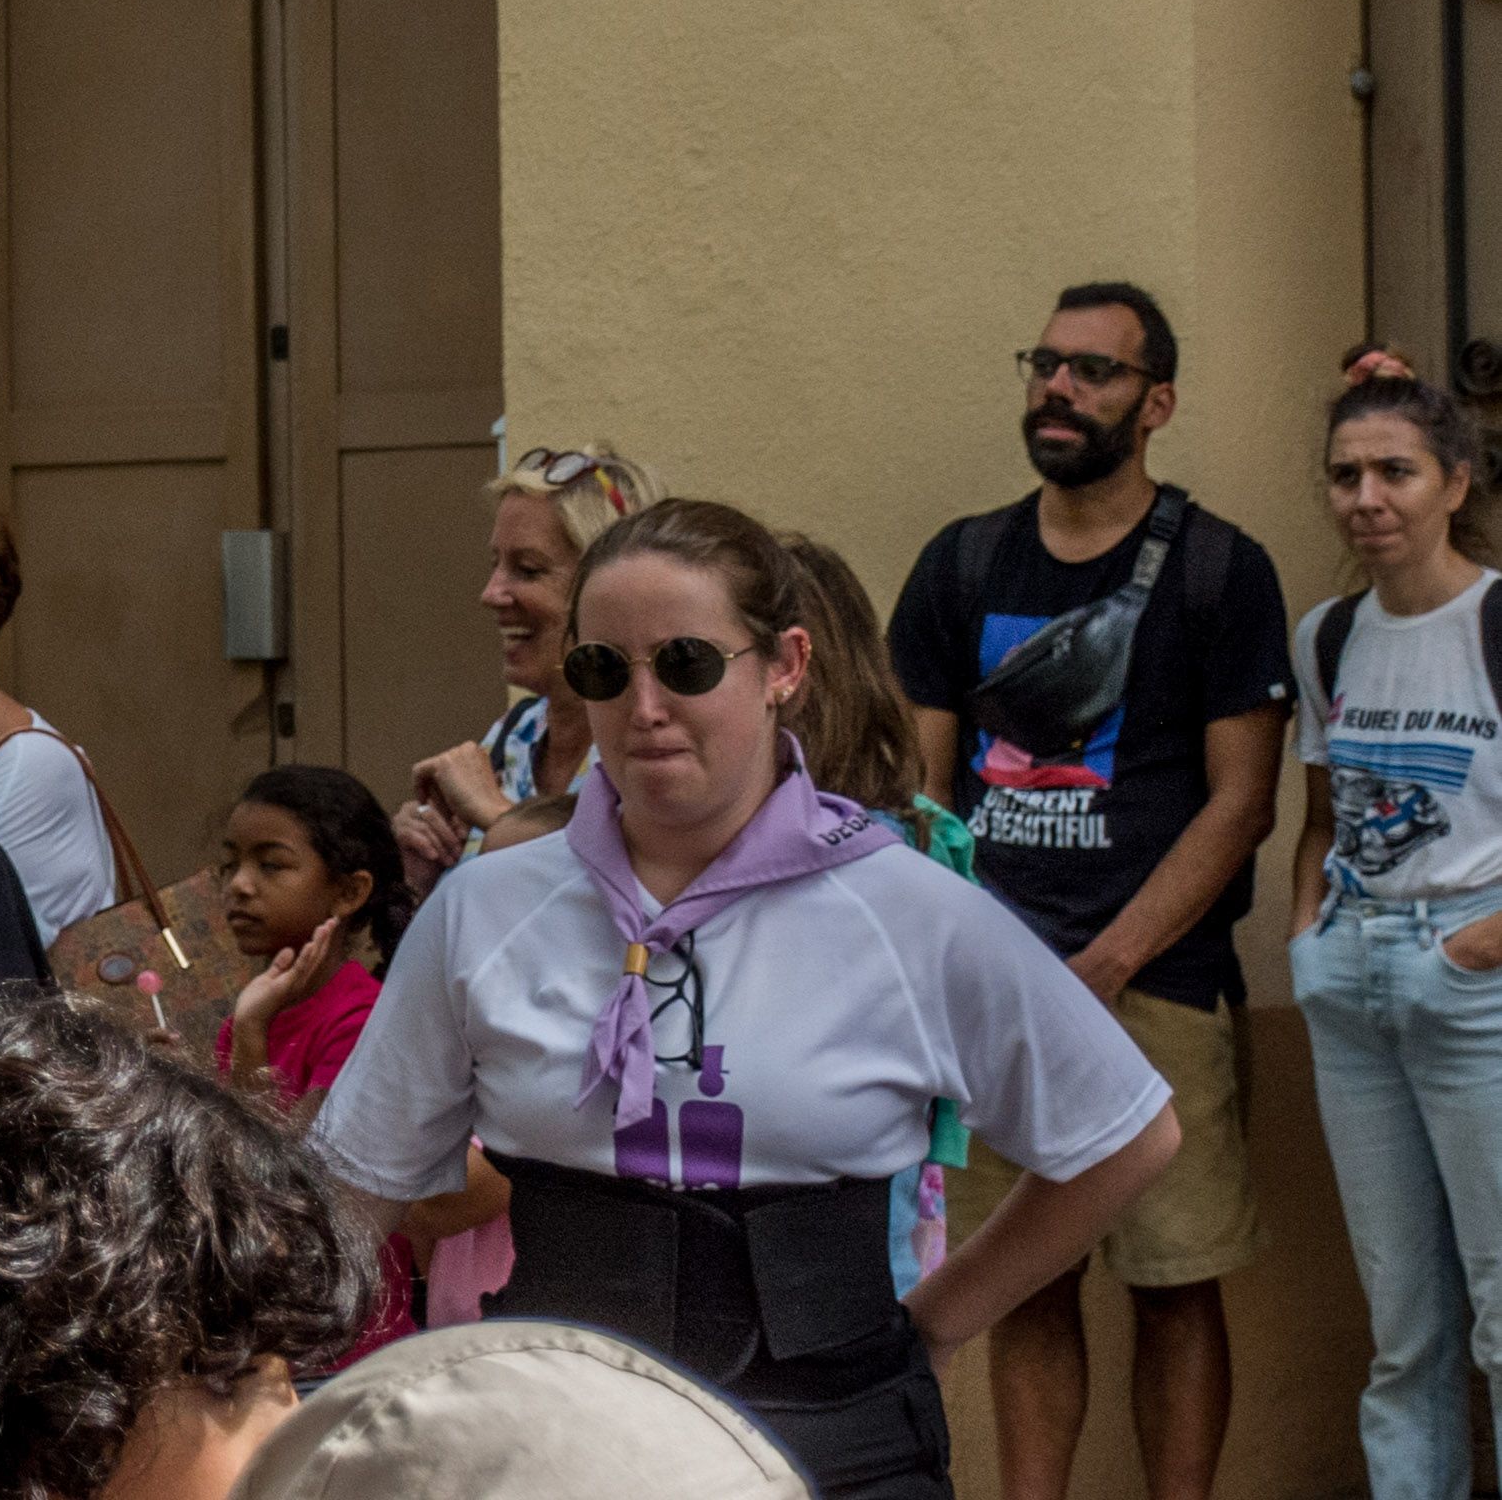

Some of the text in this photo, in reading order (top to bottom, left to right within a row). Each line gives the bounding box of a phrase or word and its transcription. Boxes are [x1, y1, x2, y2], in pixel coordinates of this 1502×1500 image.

[1403, 710, 1435, 733] DU
[1436, 711, 1499, 740] MANS
[990, 810, 1113, 850] BEAUTIFUL
